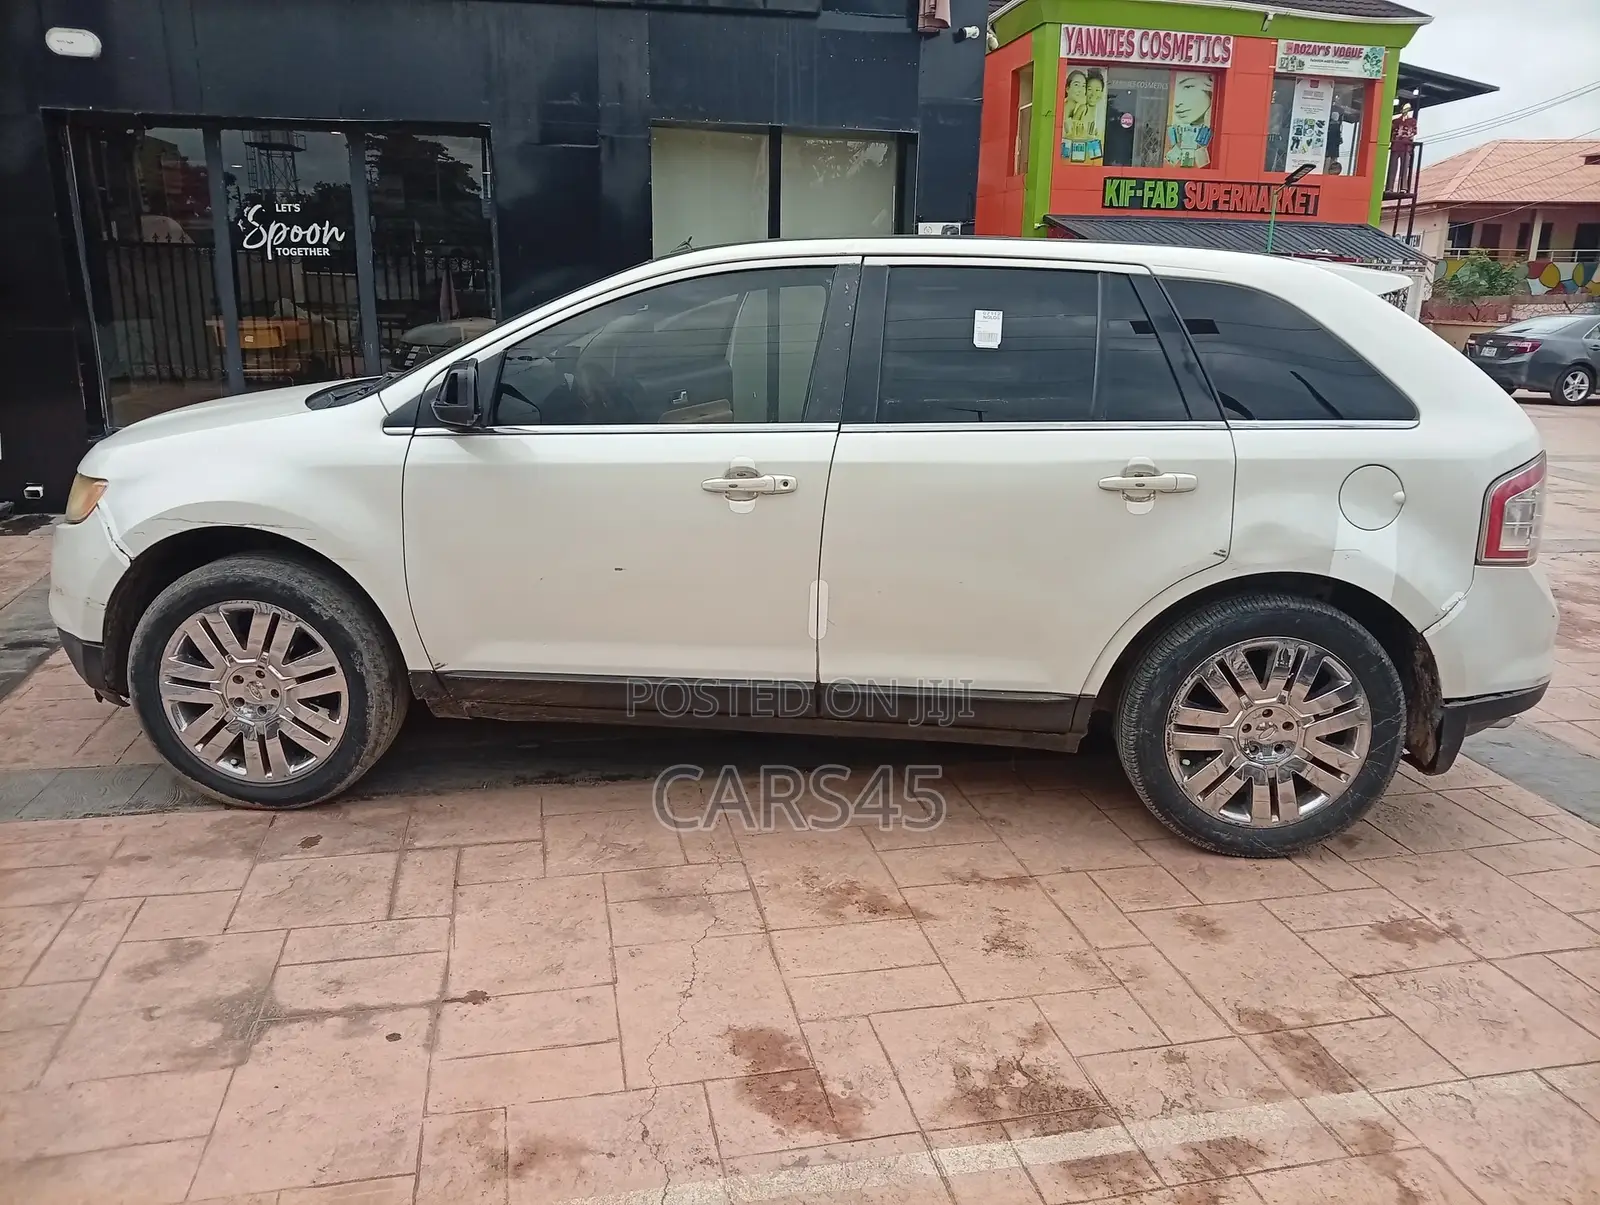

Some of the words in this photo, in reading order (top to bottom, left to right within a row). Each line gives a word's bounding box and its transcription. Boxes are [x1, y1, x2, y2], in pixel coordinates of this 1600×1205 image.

[1065, 27, 1135, 58] YANNIES
[1139, 30, 1231, 63] COSMETICS
[1293, 43, 1330, 56] ROZAY'S
[1333, 46, 1364, 58] VOGUE
[275, 203, 301, 212] LET'S
[1104, 178, 1179, 209] KIF-FAB
[1184, 181, 1319, 214] SUPERMARKET
[242, 204, 346, 260] Spoon
[275, 247, 331, 256] TOGETHER
